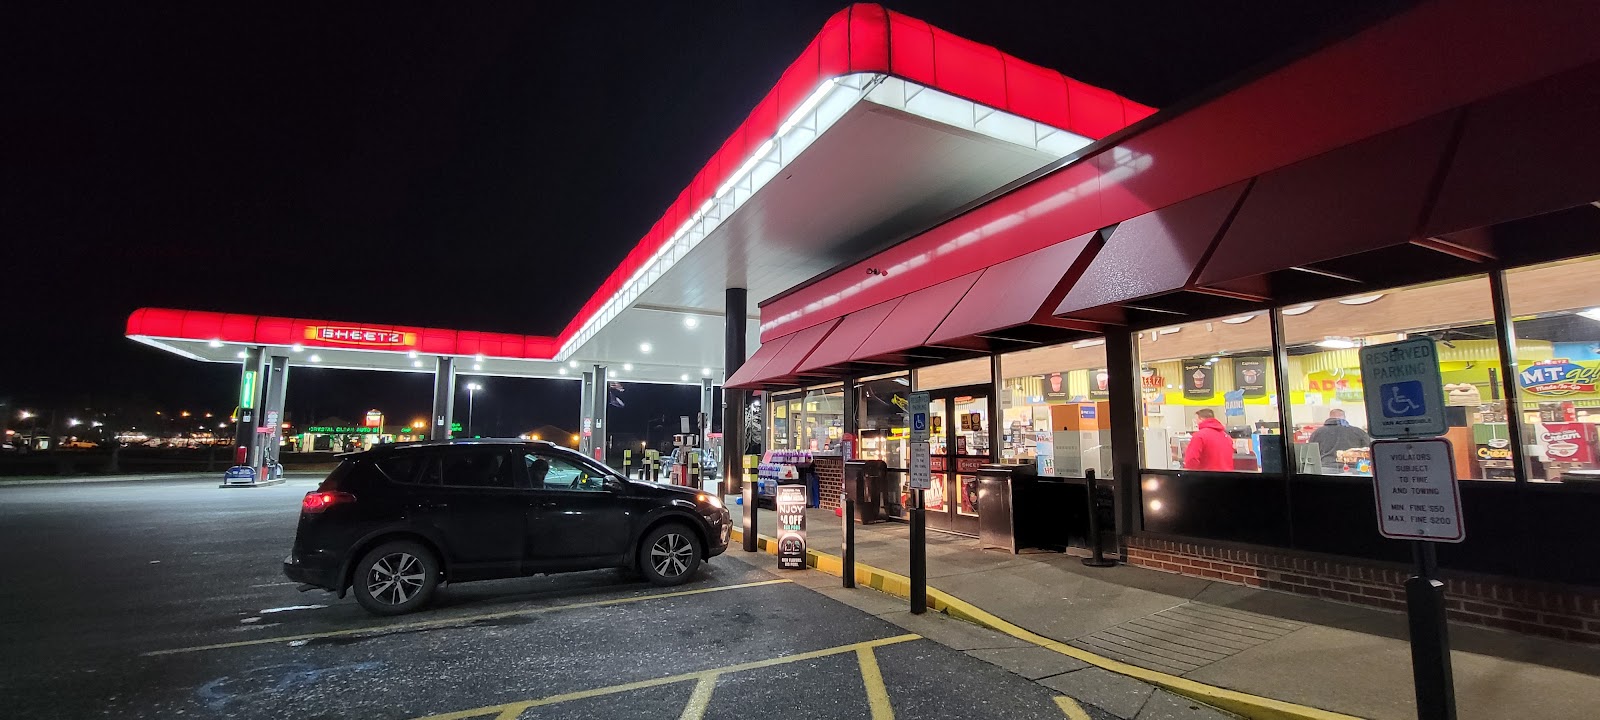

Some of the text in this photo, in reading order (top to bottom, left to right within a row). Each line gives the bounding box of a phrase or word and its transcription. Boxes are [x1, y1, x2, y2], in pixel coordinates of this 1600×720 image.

[322, 328, 399, 342] SHEETZ
[1365, 345, 1430, 365] RESERVED
[1373, 362, 1426, 379] PARKING
[1391, 453, 1431, 461] VIOLATORS
[1477, 447, 1511, 458] Crea
[1411, 487, 1439, 495] TOWING
[779, 504, 804, 514] NJOY
[1409, 504, 1427, 512] FINE
[1429, 505, 1445, 513] $50
[788, 514, 803, 525] OFF
[1410, 515, 1428, 524] FINE
[1429, 516, 1451, 525] $200
